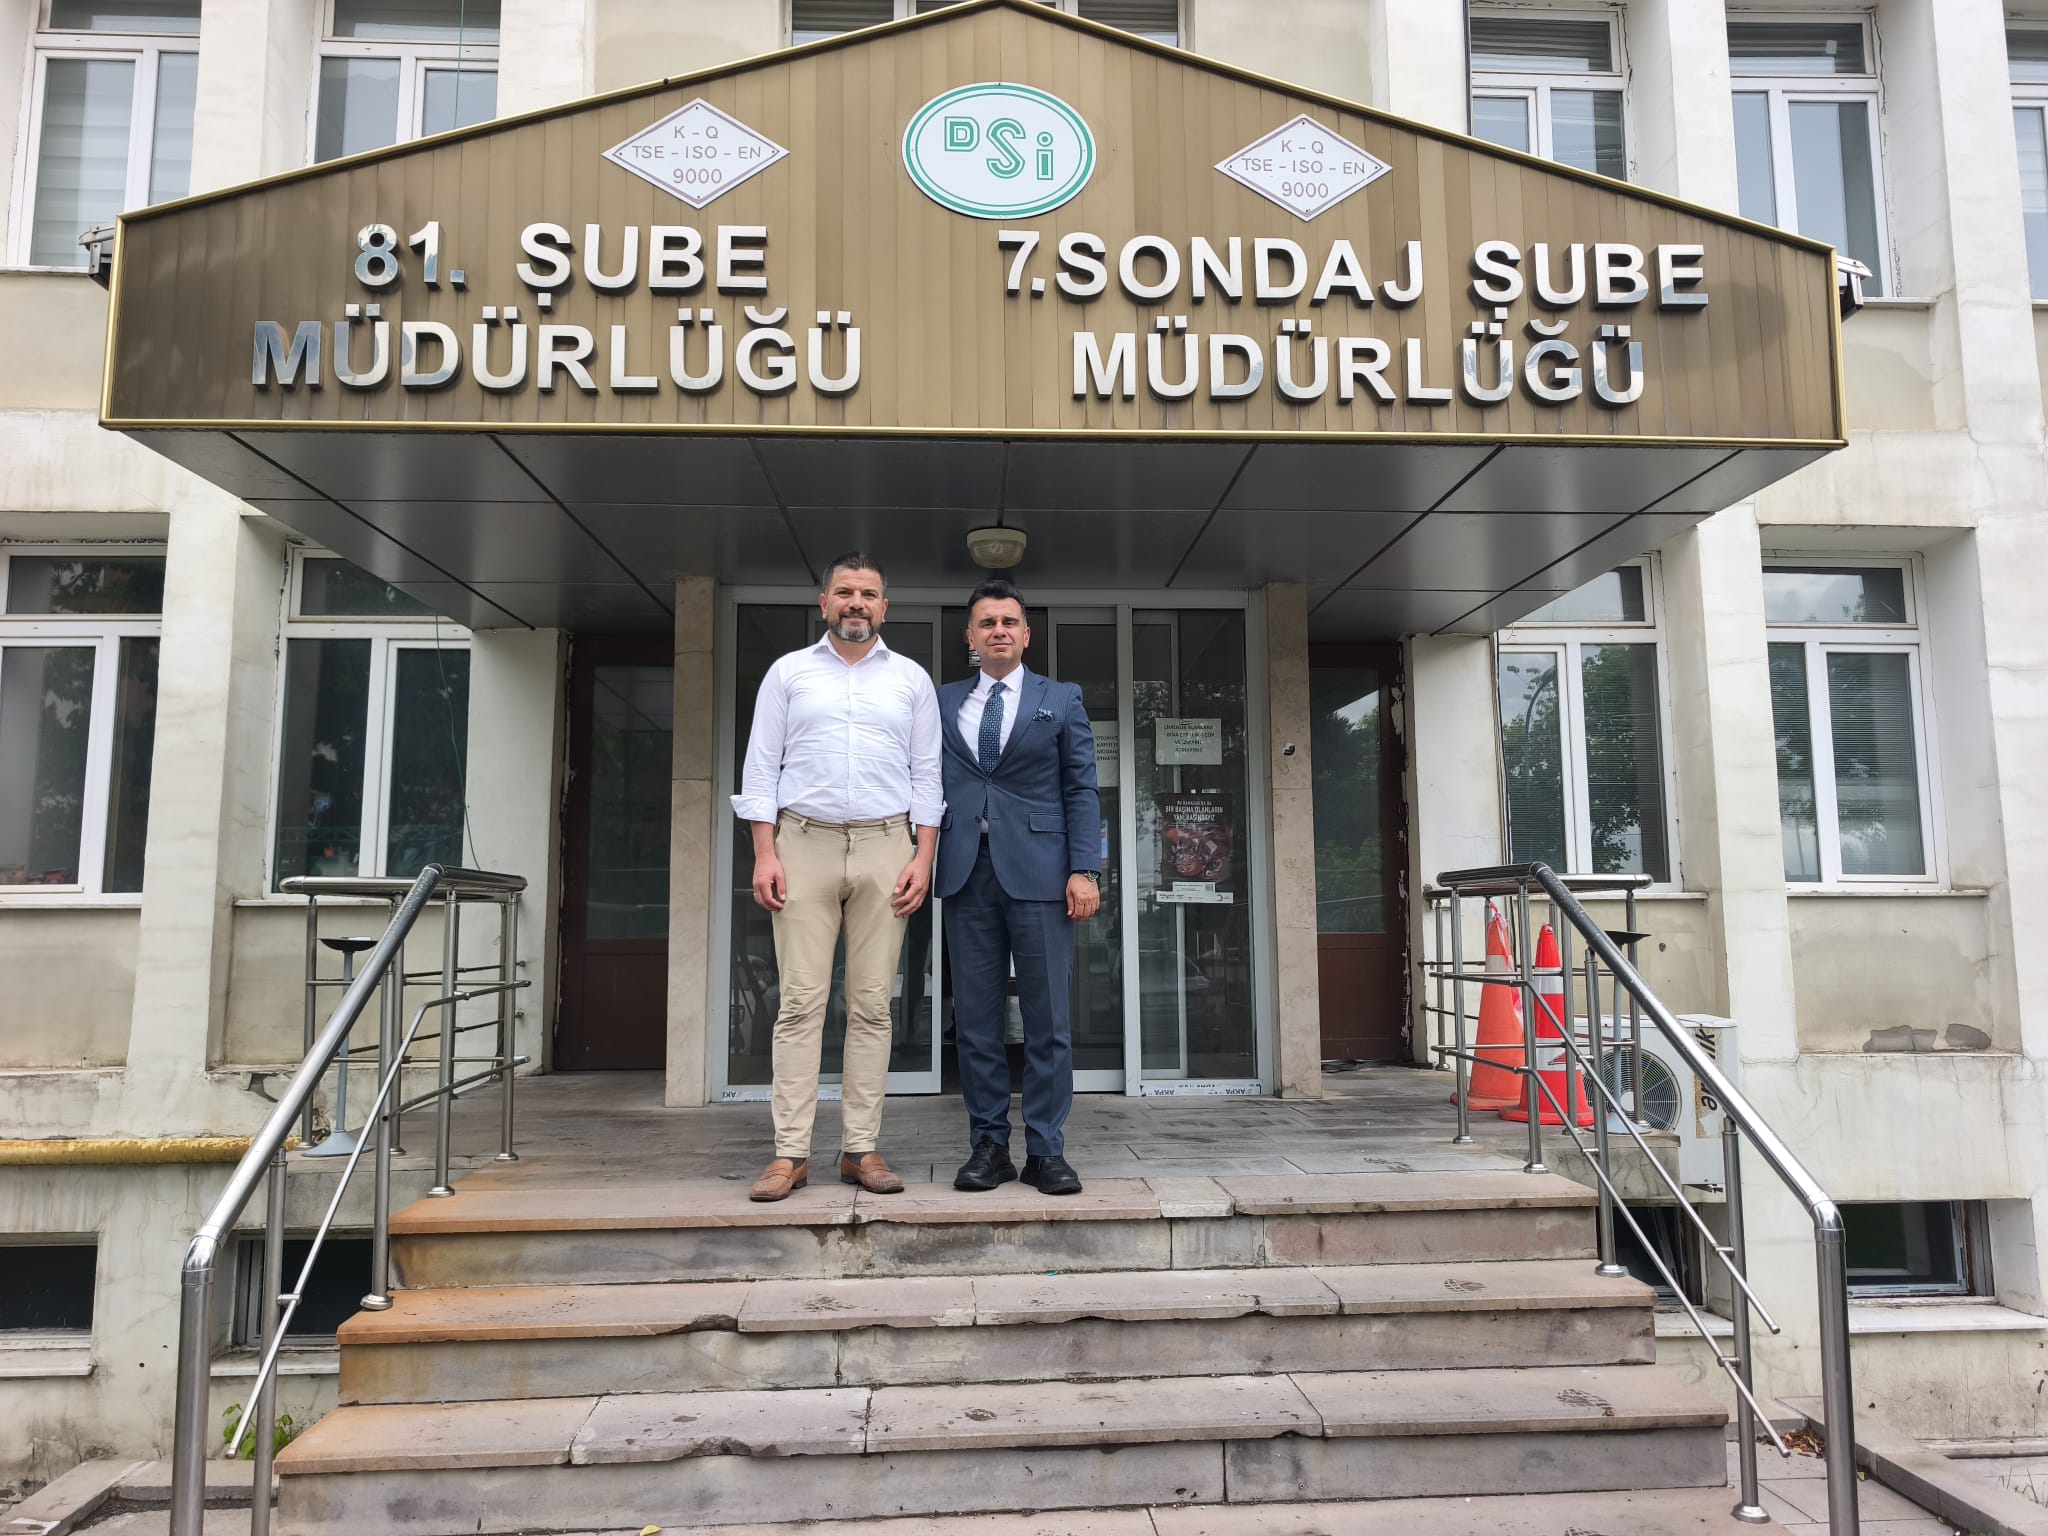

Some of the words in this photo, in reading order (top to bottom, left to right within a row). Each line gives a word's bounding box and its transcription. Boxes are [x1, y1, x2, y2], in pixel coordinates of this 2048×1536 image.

[674, 125, 685, 139] K
[705, 125, 718, 139] Q
[631, 145, 665, 159] TSE
[685, 145, 717, 159] ISO
[738, 146, 761, 159] EN
[944, 116, 1053, 180] DSi
[1281, 140, 1292, 153] K
[1311, 140, 1324, 154] Q
[1241, 157, 1273, 172] TSE
[1292, 159, 1323, 174] ISO
[1343, 161, 1365, 175] EN
[673, 168, 722, 184] 9000
[1281, 181, 1329, 198] 9000
[355, 221, 466, 288] 81.
[516, 222, 769, 307] ŞUBE
[998, 230, 1424, 304] 7.SONDAJ
[1472, 240, 1709, 320] ŞUBE
[252, 303, 862, 393] MÜDÜRLÜĞÜ
[1072, 315, 1645, 405] MÜDÜRLÜĞÜ
